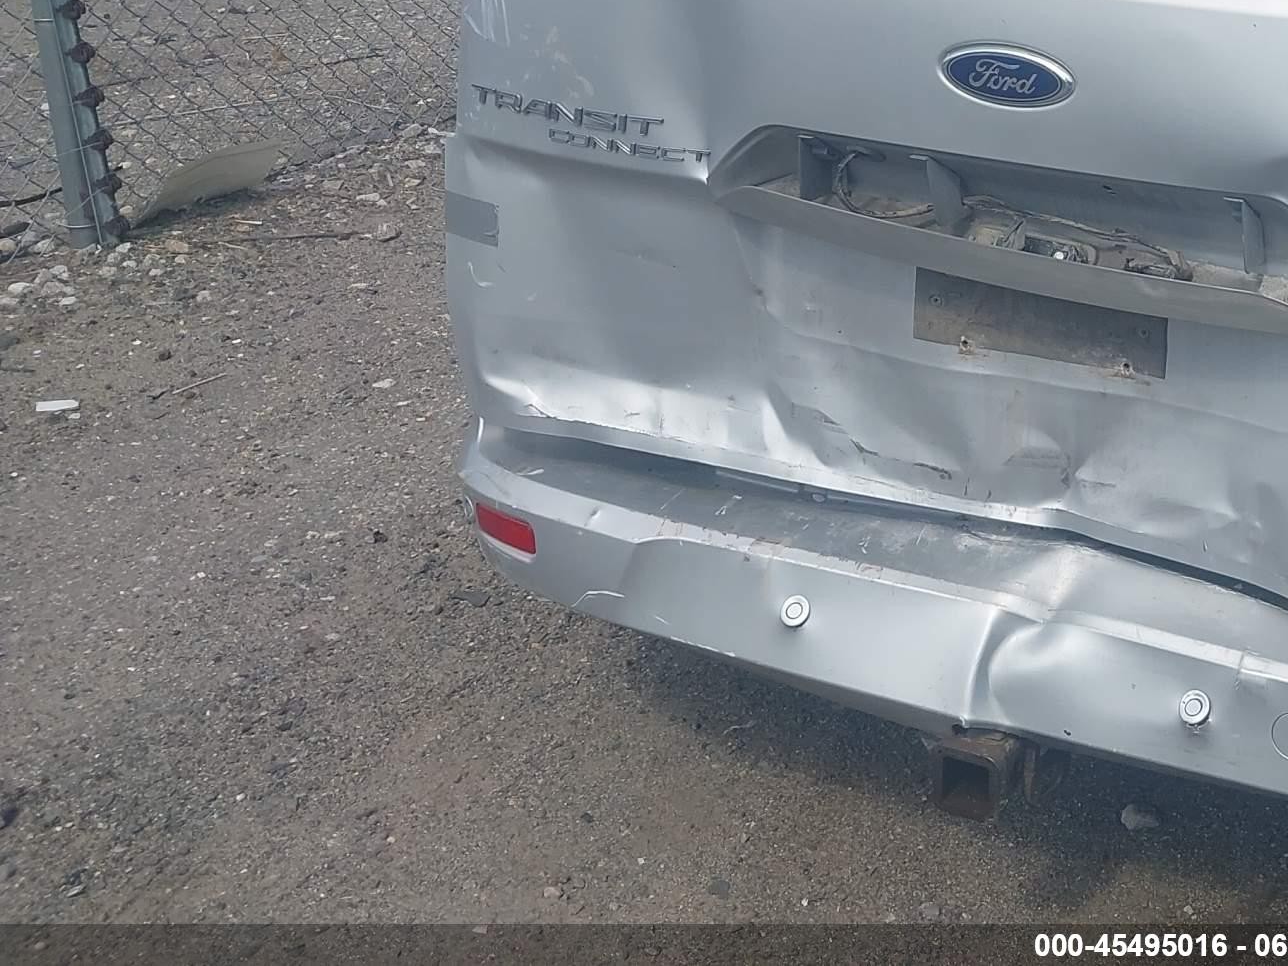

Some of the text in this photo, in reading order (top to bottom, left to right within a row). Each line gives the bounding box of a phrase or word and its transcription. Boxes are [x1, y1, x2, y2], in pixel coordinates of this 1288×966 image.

[968, 57, 1040, 95] Ford
[472, 83, 665, 136] TRANSIT
[548, 128, 711, 163] CONNECT
